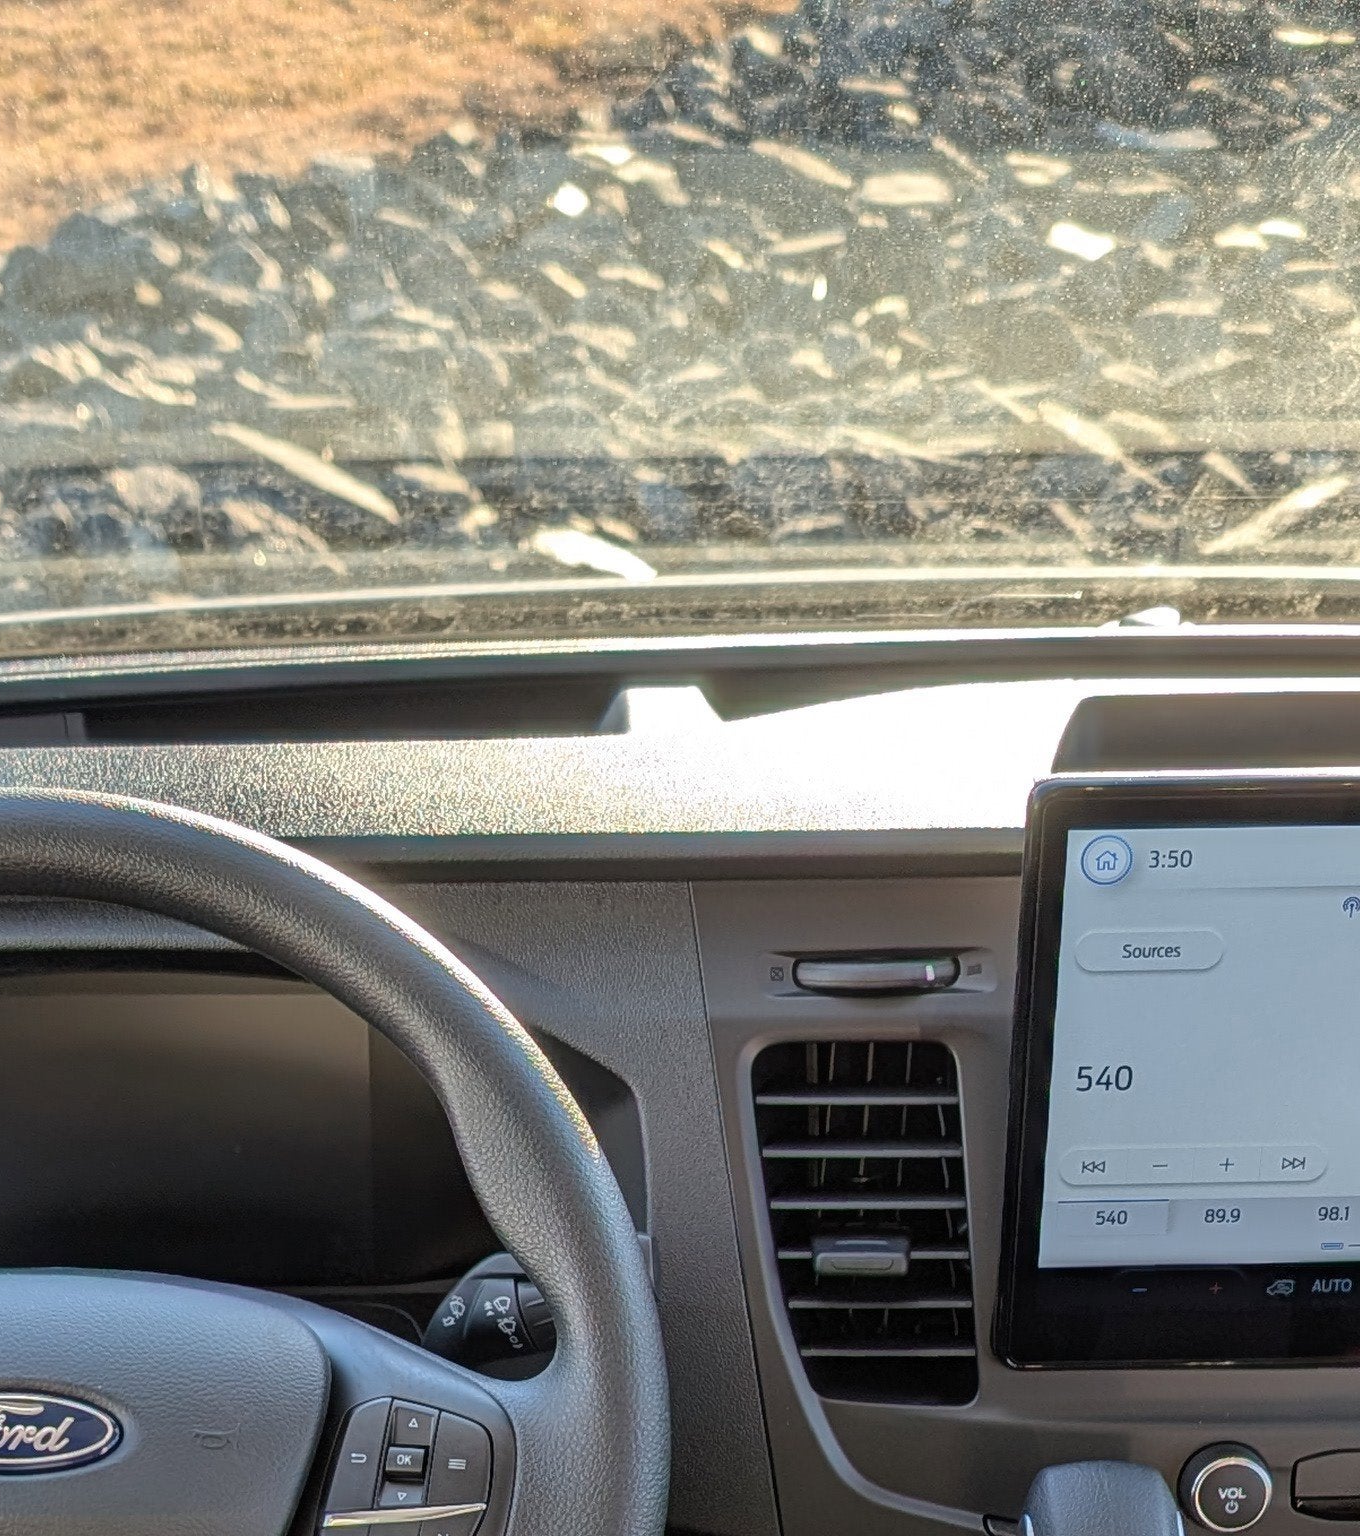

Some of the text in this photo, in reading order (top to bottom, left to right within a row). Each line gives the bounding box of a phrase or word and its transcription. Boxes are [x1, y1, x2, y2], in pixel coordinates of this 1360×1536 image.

[1148, 849, 1194, 869] 3:50
[1121, 943, 1182, 959] Sources
[1075, 1064, 1134, 1092] 540
[1094, 1209, 1128, 1226] 540
[1203, 1207, 1241, 1224] 89.9
[1317, 1206, 1351, 1222] 98.1
[1311, 1278, 1353, 1293] AUTO
[396, 1455, 412, 1466] OK
[1217, 1486, 1247, 1499] VOL
